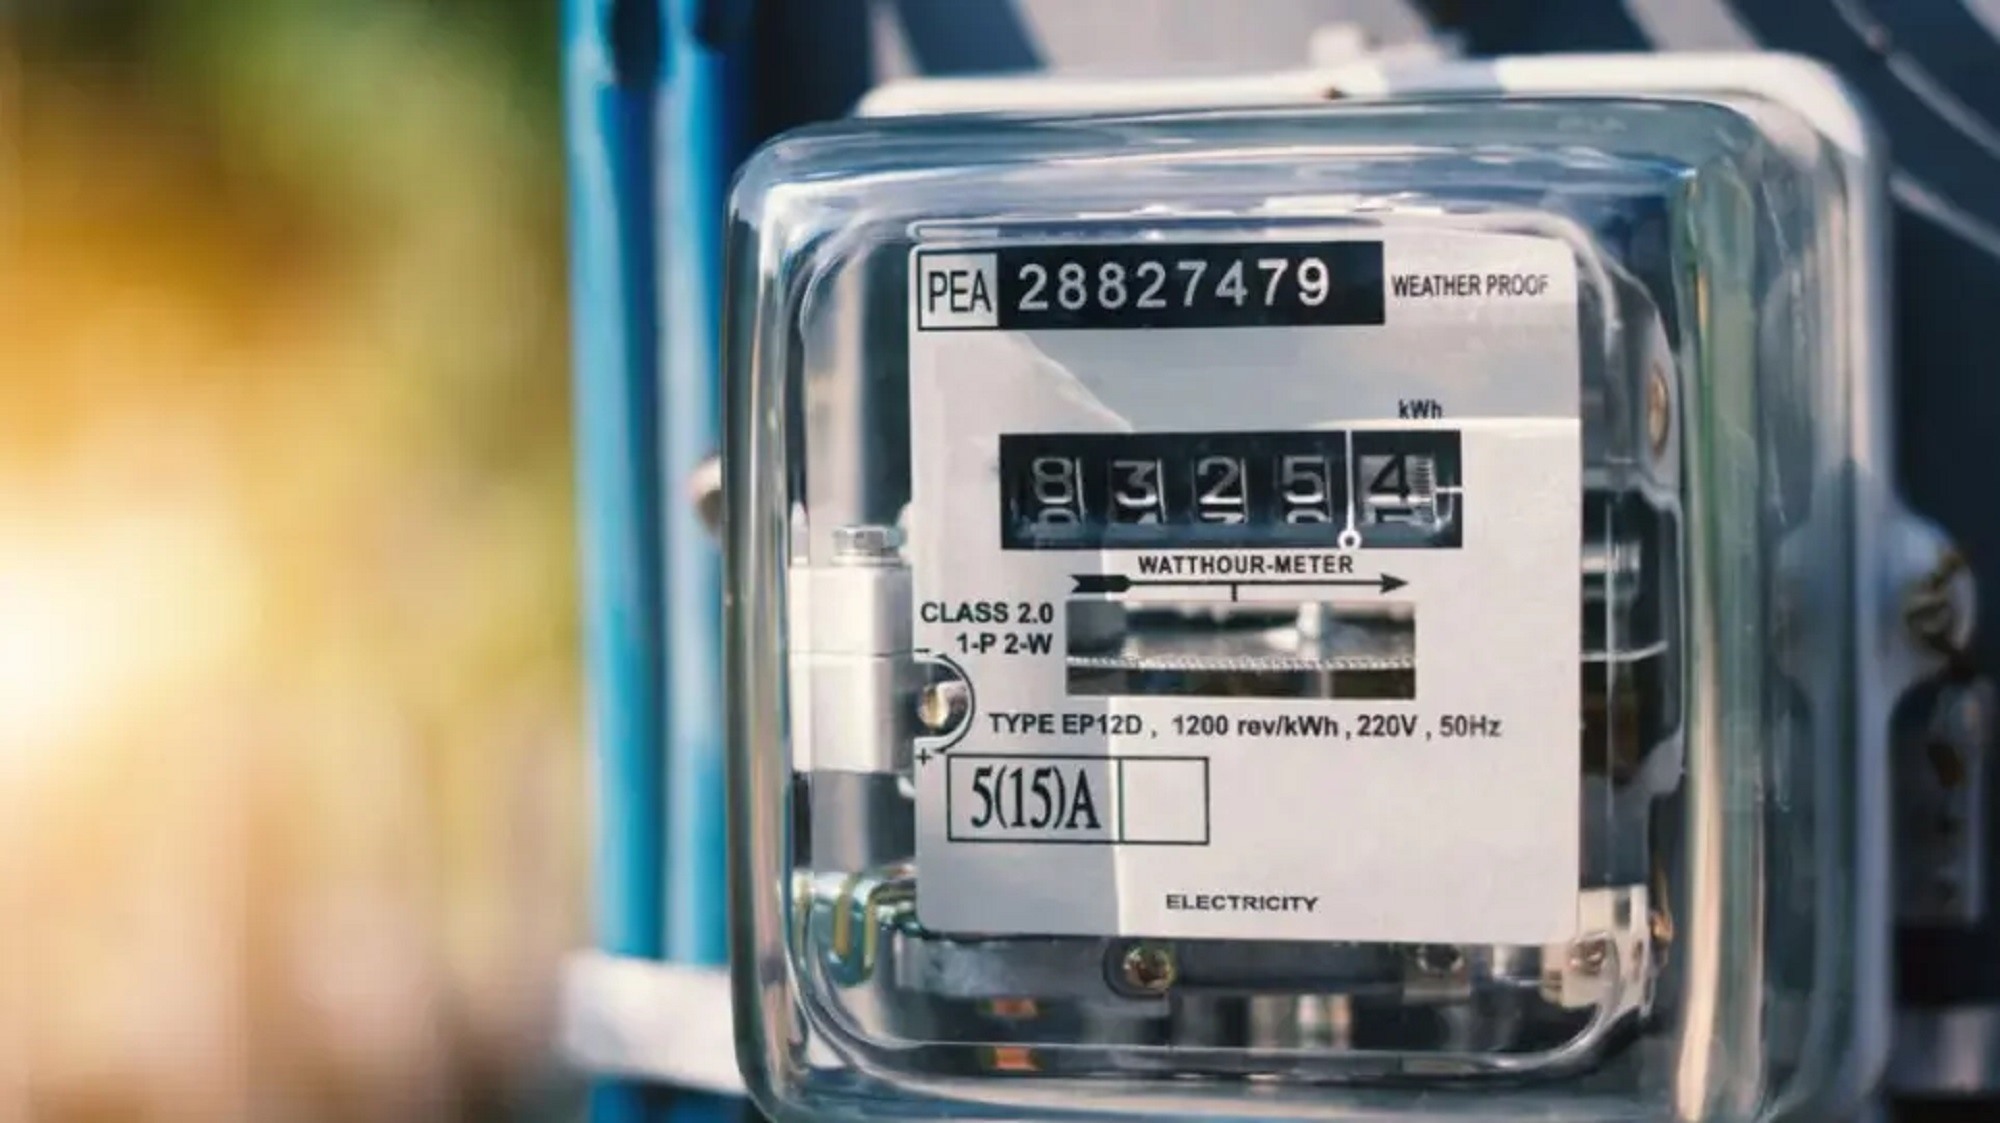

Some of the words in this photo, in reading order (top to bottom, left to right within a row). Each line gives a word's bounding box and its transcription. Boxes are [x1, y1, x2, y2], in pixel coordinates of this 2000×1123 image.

[928, 269, 991, 313] PEA
[1018, 257, 1330, 310] 28827479
[1392, 274, 1480, 297] WEATHER
[1485, 273, 1550, 296] PROOF
[1398, 399, 1443, 420] kWh
[1138, 555, 1354, 575] WATTHOUR-METER
[920, 601, 1009, 624] CLASS
[1017, 601, 1053, 623] 2.0
[956, 633, 997, 655] 1-P
[1003, 633, 1052, 655] 2-W
[991, 713, 1056, 734] TYPE
[1062, 713, 1142, 735] EP12D
[1172, 714, 1229, 736] 1200
[1237, 714, 1339, 736] rev/kWh
[1357, 715, 1416, 737] 220V
[1440, 715, 1502, 738] 50Hz
[970, 765, 1101, 830] 5(15)A
[1165, 893, 1319, 912] ELECTRICITY
